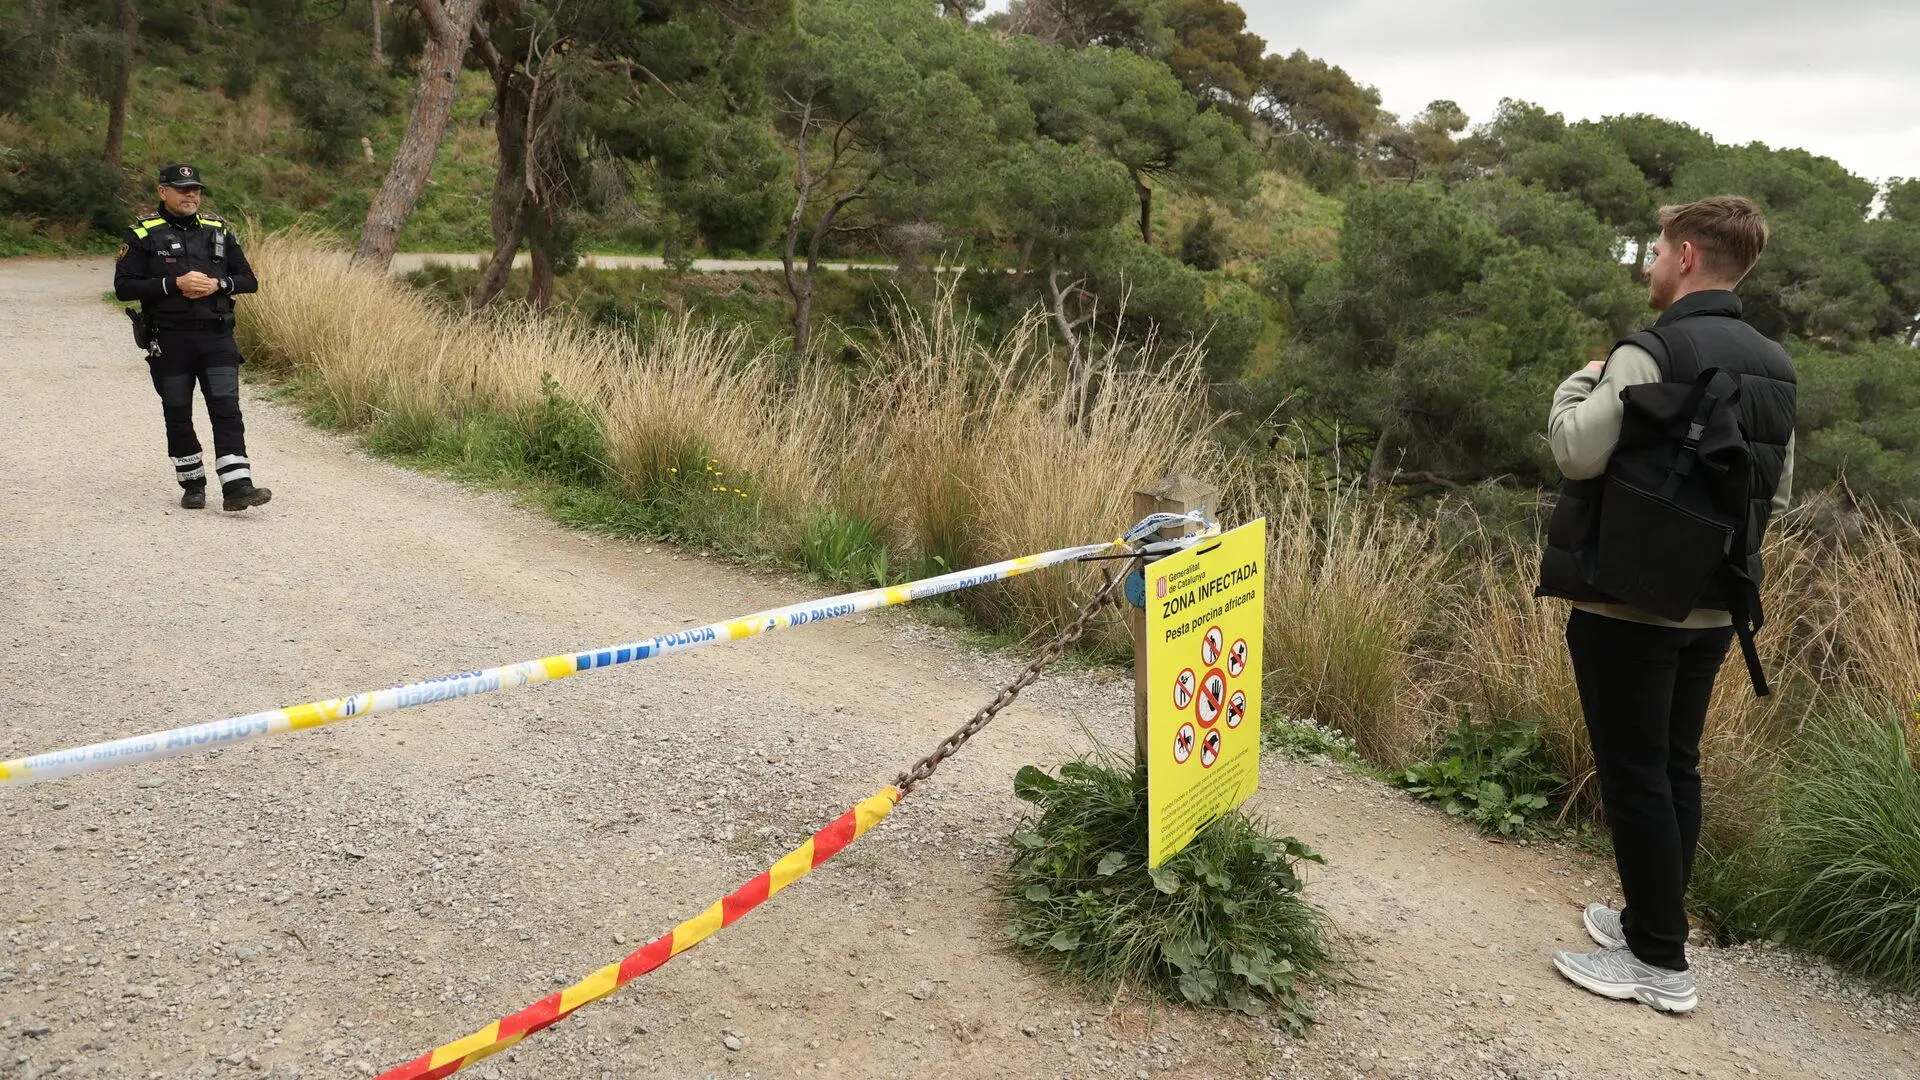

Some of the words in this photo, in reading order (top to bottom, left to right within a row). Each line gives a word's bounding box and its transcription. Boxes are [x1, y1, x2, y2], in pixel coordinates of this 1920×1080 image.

[1168, 562, 1200, 582] Generalitat
[1168, 585, 1176, 594] de
[1177, 571, 1206, 590] Catalunya
[910, 588, 935, 599] Guardia
[959, 573, 998, 589] POLICIA
[1163, 590, 1196, 619] ZONA
[1198, 561, 1258, 602] INFECTADA
[790, 612, 808, 627] NO
[1165, 622, 1190, 643] Pesta
[1191, 606, 1223, 633] porcina
[1224, 589, 1256, 613] africana
[654, 627, 716, 649] POLICIA
